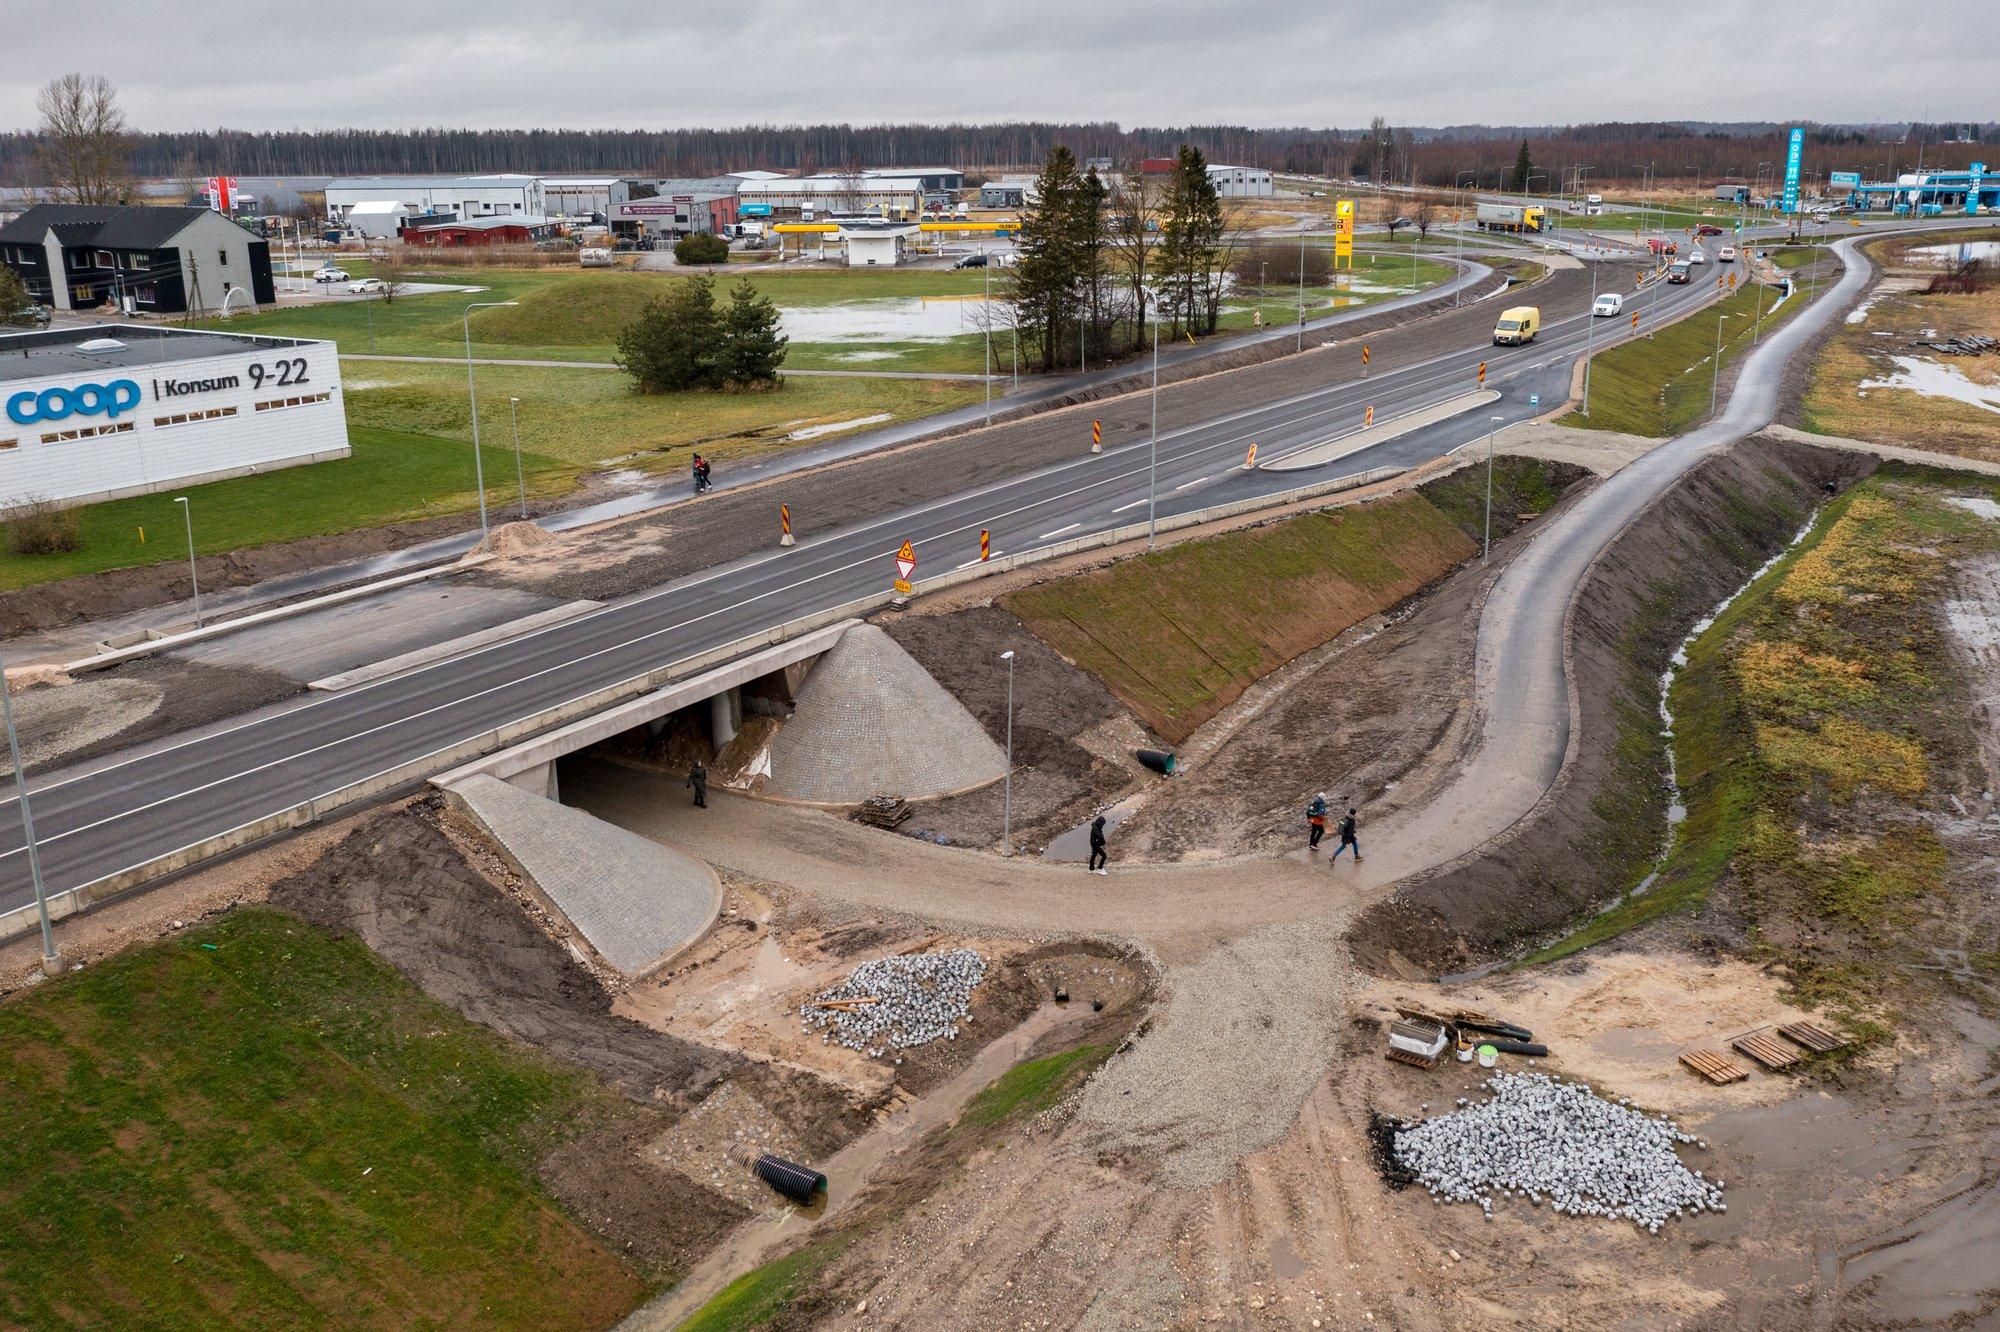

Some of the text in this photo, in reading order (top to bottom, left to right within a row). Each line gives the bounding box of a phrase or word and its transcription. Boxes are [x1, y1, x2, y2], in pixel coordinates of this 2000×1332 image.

[6, 357, 310, 424] coop Konsum 9-22
